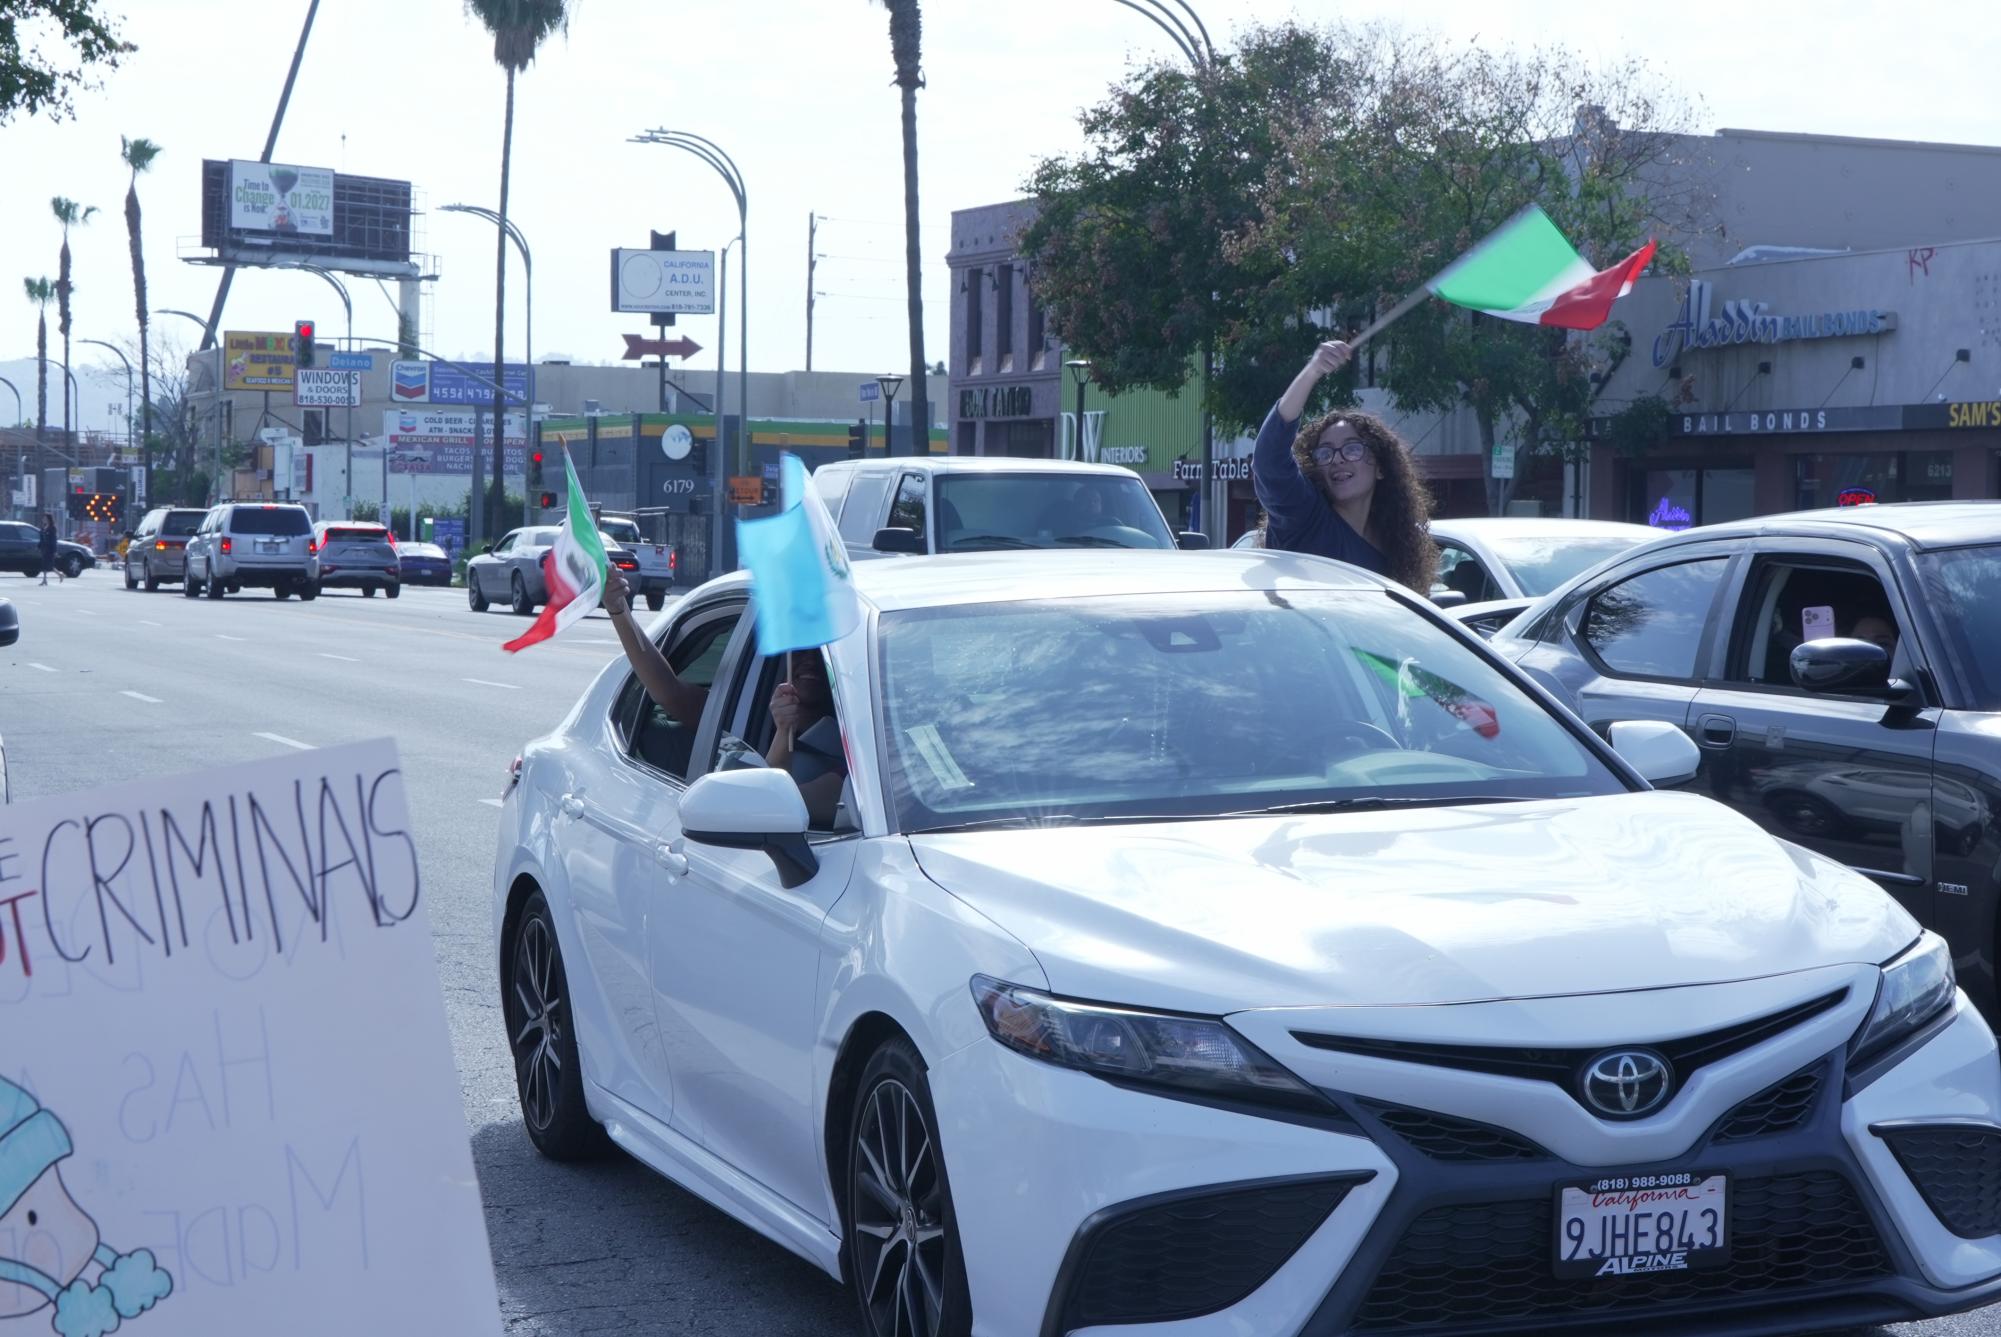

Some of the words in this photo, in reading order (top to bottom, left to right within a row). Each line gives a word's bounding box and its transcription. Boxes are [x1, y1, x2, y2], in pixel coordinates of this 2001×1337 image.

[243, 178, 260, 192] Time
[261, 182, 269, 192] to
[235, 186, 275, 208] Change
[290, 191, 330, 211] 01.2027
[663, 260, 709, 269] CALIFORNIA
[669, 273, 703, 284] A.D.U.
[1652, 280, 1783, 369] Aladdin
[1783, 315, 1817, 339] BAIL
[1823, 309, 1882, 336] BONDS
[331, 356, 371, 368] Delano
[300, 371, 359, 386] WINDOWS
[315, 386, 348, 395] DOORS
[444, 417, 462, 425] BEER
[1684, 415, 1732, 433] BAIL
[1750, 410, 1827, 431] BONDS
[1949, 401, 2001, 428] SAM'S
[398, 436, 440, 444] MEXICAN
[442, 436, 469, 445] GRILL
[444, 447, 471, 455] TACOS
[481, 448, 523, 457] BUITOS
[1101, 446, 1145, 464] INTERIORS
[446, 463, 473, 471] NACH
[1211, 456, 1250, 480] Table
[1927, 464, 1951, 478] 6213
[663, 479, 695, 494] 6179
[1838, 492, 1876, 507] OPEN
[1597, 1178, 1629, 1191] (818)
[1631, 1173, 1691, 1189] 988-9088
[1591, 1186, 1700, 1212] California
[1565, 1207, 1719, 1261] 9JHE843
[1595, 1252, 1688, 1277] ALPINE
